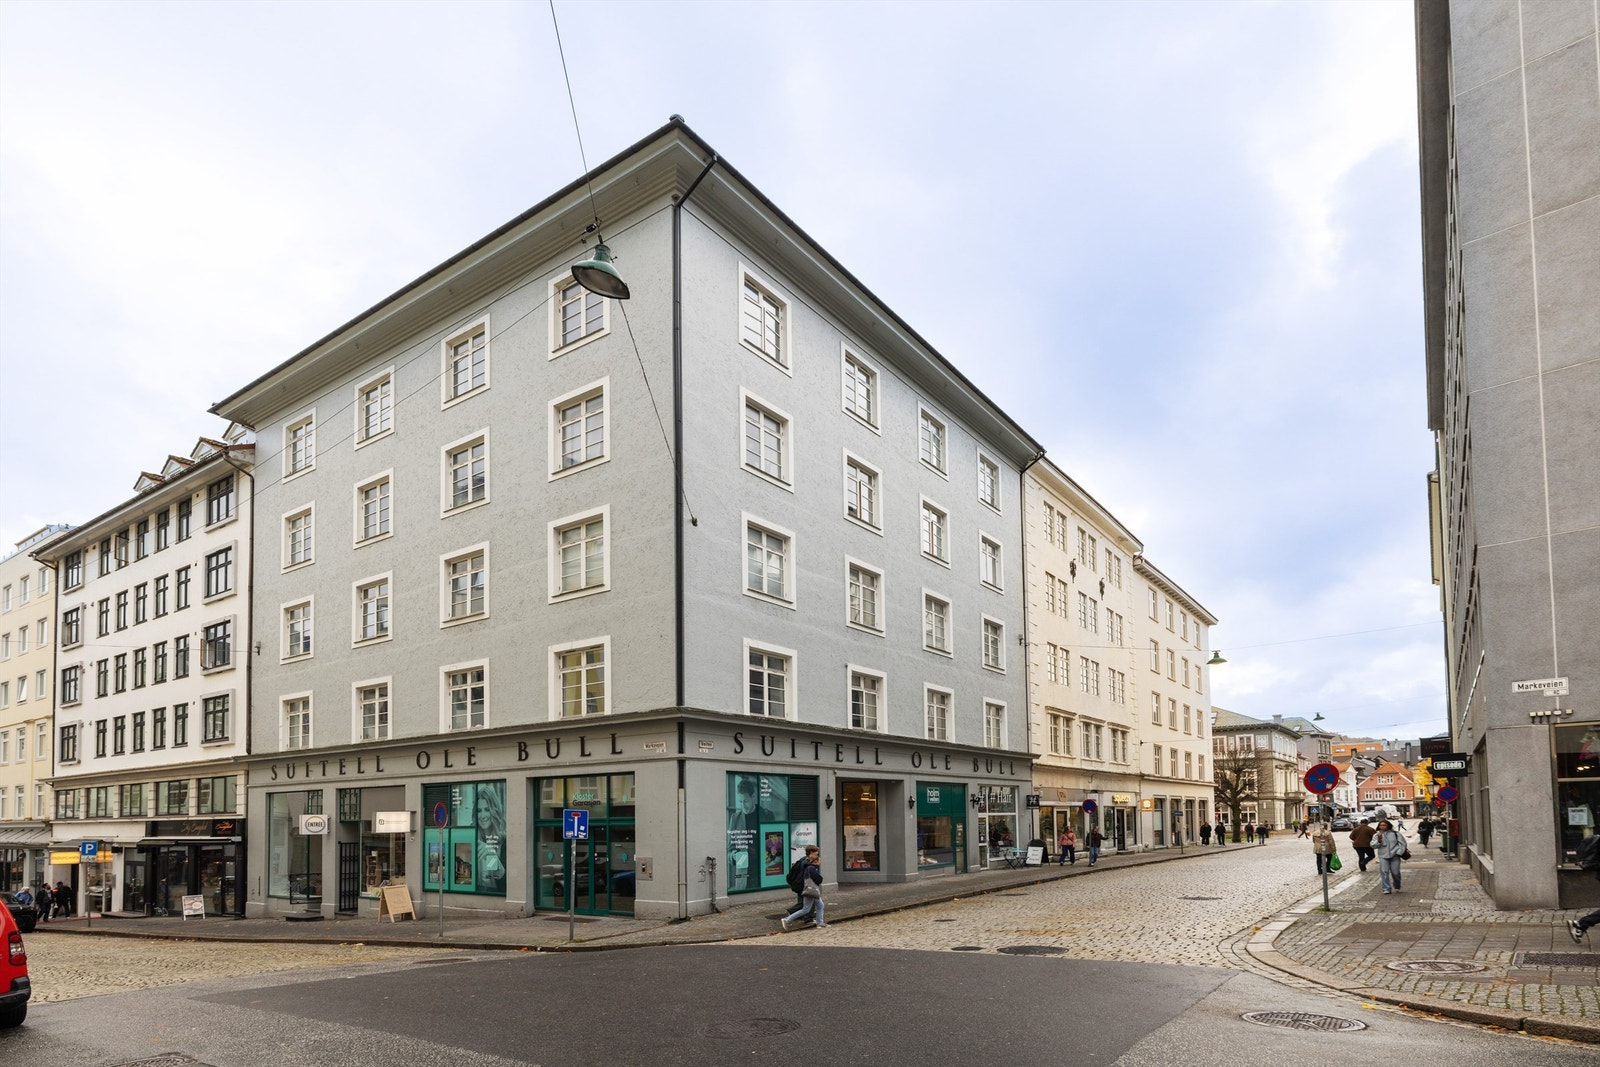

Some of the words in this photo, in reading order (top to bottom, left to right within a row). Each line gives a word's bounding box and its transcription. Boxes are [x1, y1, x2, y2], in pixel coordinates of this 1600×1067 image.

[1517, 681, 1564, 690] Markeveien
[270, 755, 384, 781] SUITELL
[416, 746, 476, 770] OLE
[517, 732, 623, 762] BULL
[733, 731, 883, 766] SUITELL
[911, 751, 952, 771] OLE
[972, 757, 1017, 776] BULL
[1437, 761, 1463, 770] episode
[997, 790, 1013, 804] Hair
[85, 843, 94, 854] P
